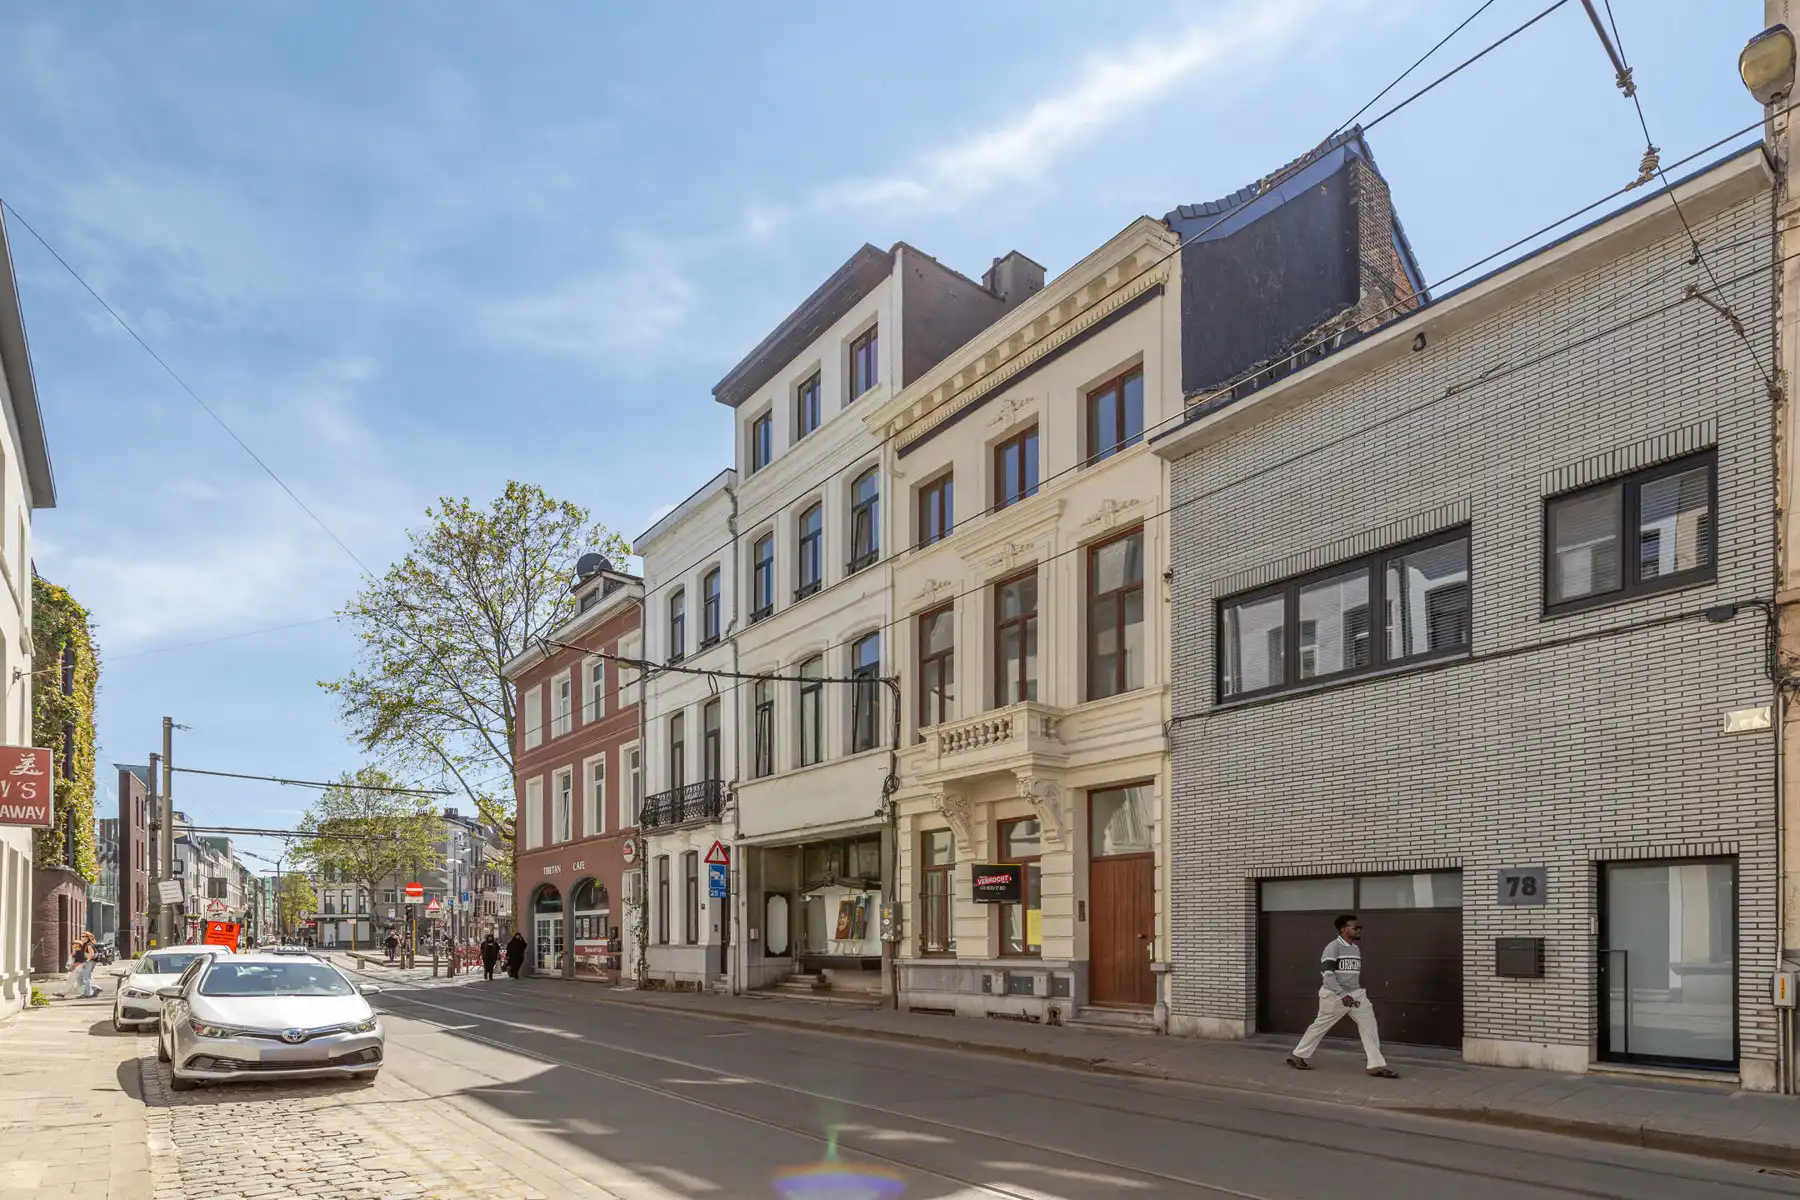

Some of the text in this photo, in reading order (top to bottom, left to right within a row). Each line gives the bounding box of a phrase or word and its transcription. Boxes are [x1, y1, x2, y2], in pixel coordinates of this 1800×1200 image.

[0, 804, 46, 820] AWAY
[543, 864, 562, 876] TIBETAN
[977, 874, 1010, 885] VERKOCHT
[1506, 876, 1537, 897] 78
